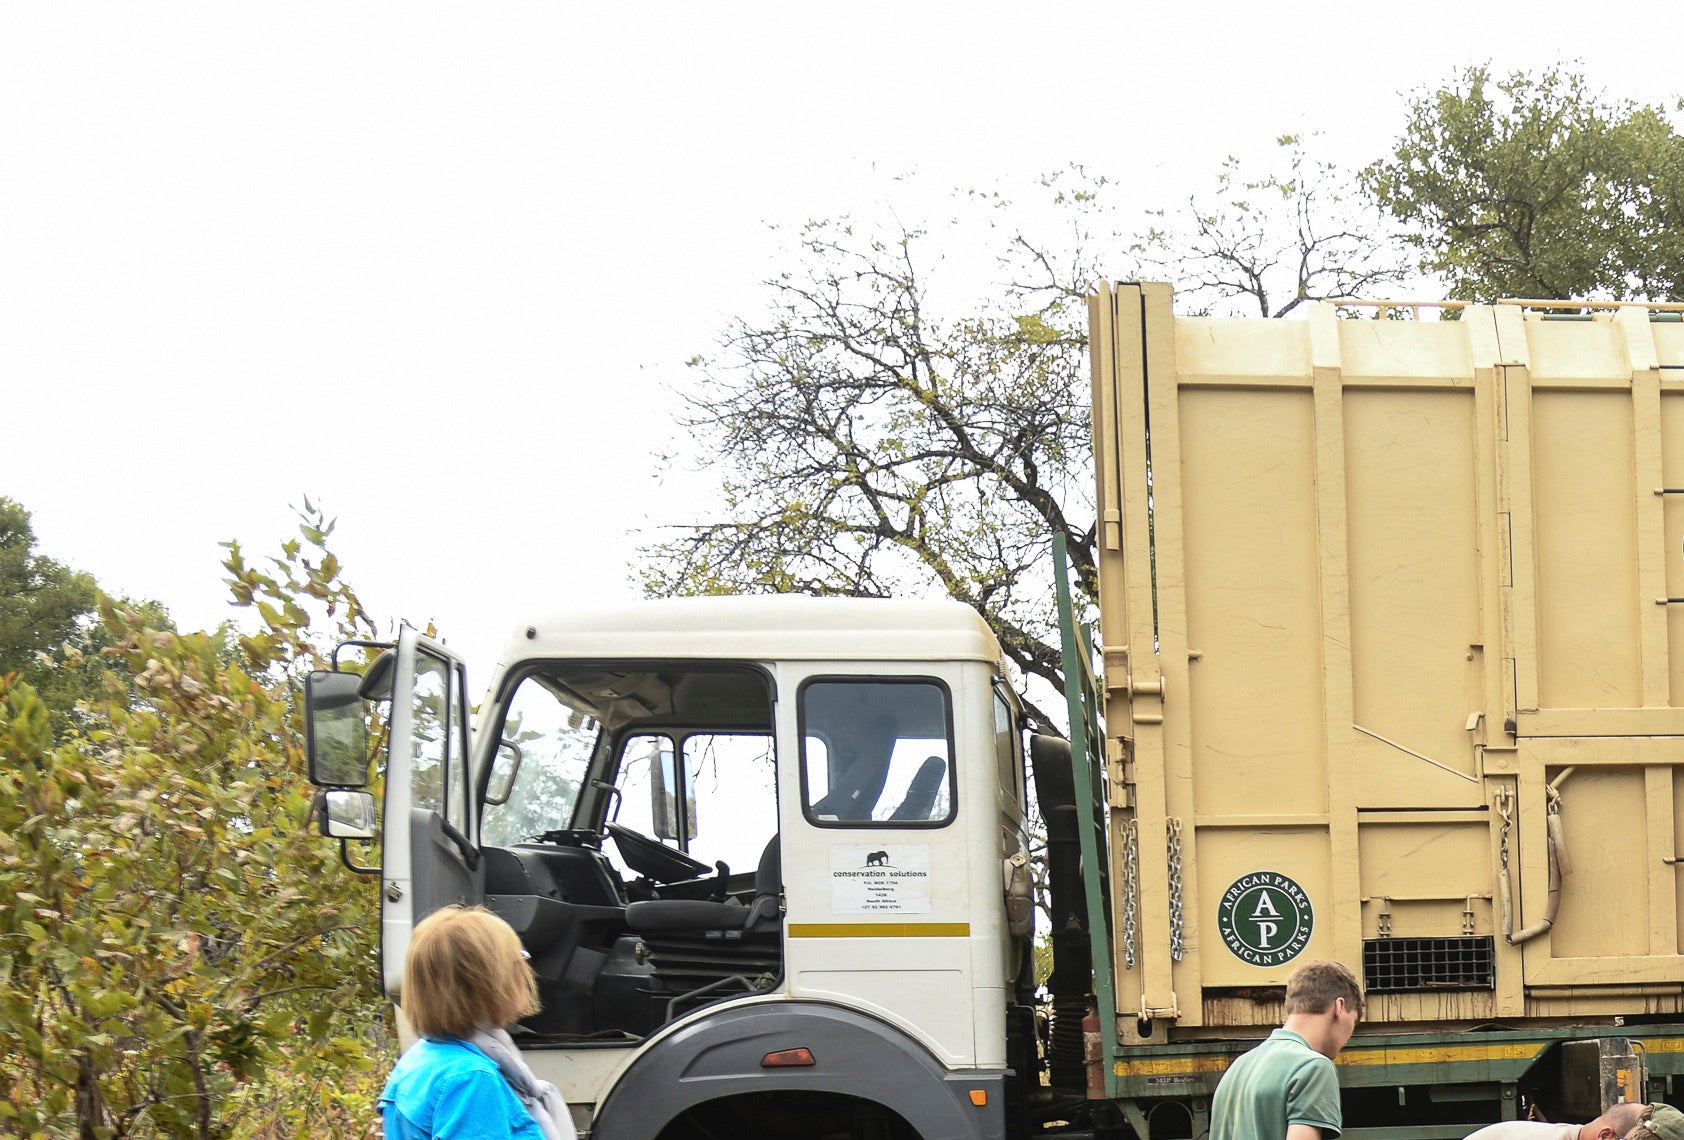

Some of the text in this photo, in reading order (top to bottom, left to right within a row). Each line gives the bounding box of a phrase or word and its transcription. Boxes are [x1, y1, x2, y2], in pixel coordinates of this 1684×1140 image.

[1222, 874, 1308, 910] AFRICAN PARKS
[1251, 889, 1281, 917] A
[1222, 926, 1309, 964] AFRICAN PARKS
[1256, 921, 1278, 948] P
